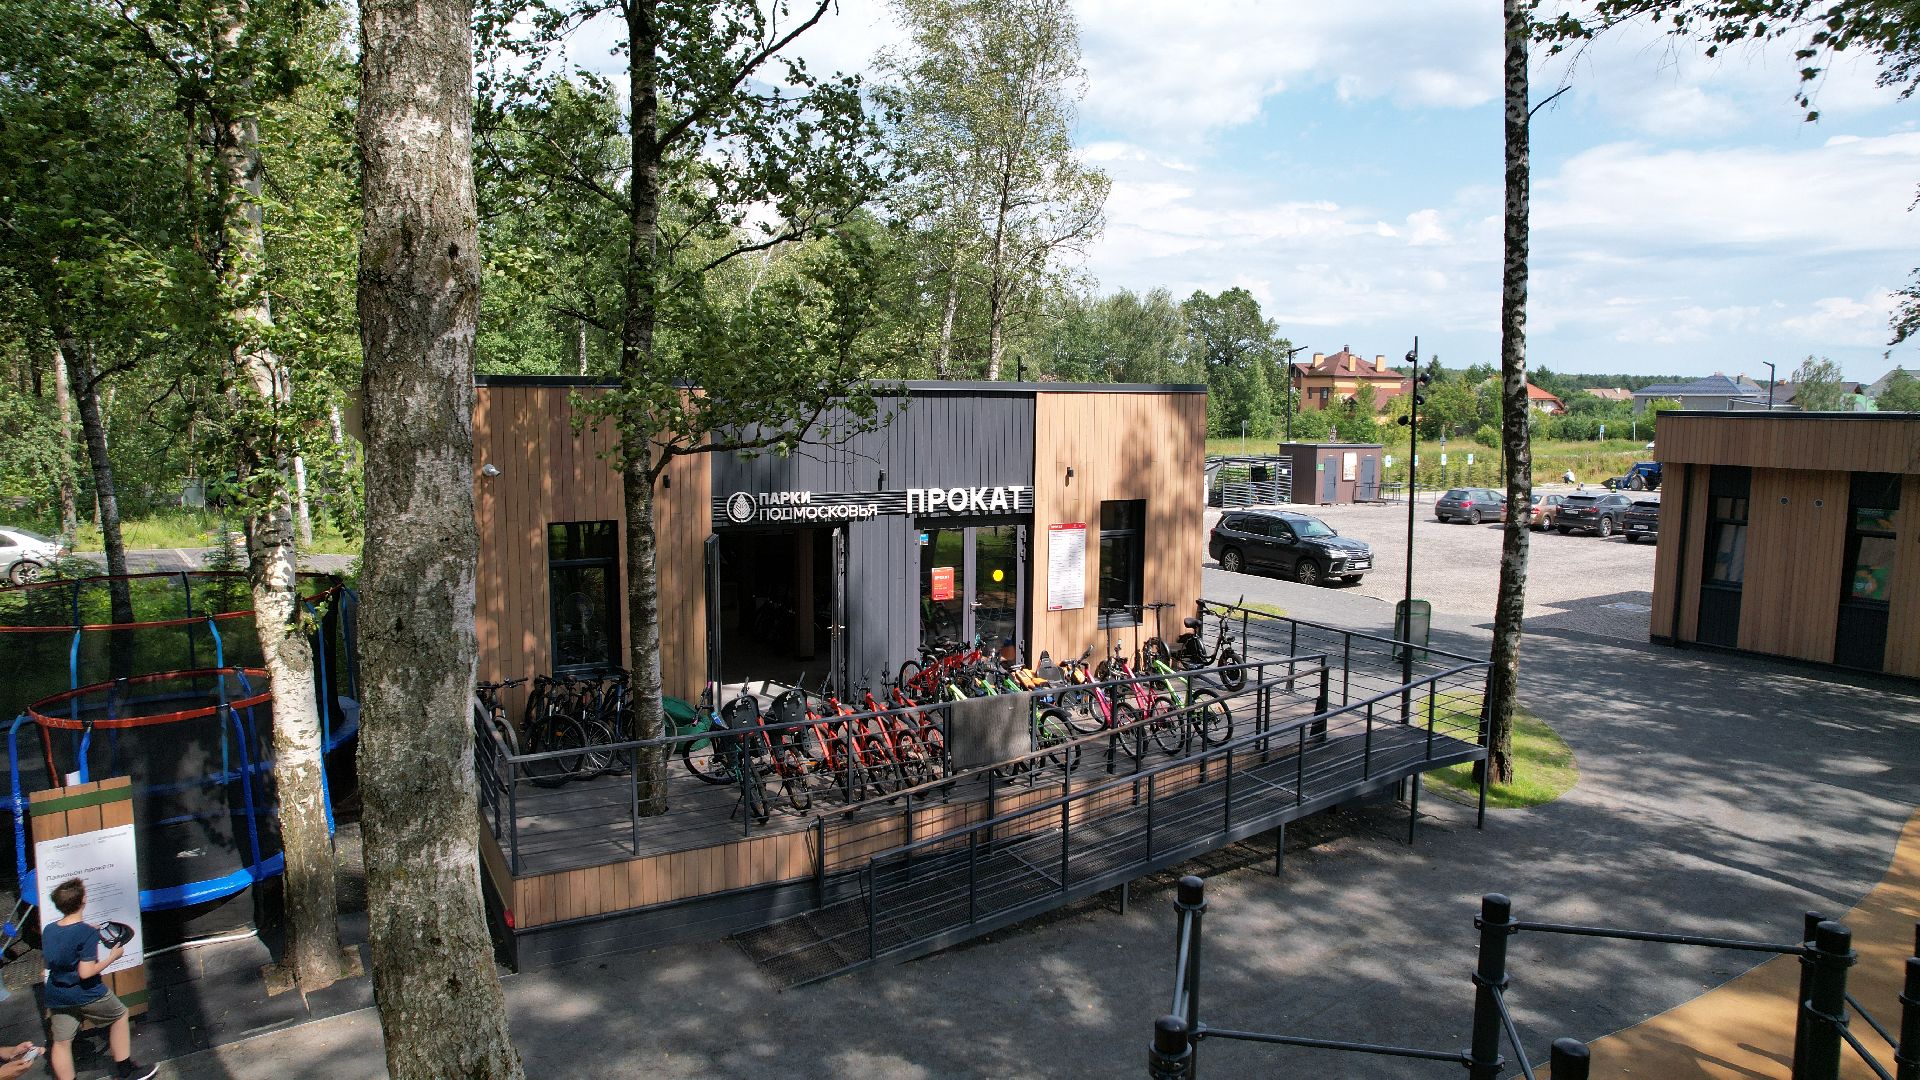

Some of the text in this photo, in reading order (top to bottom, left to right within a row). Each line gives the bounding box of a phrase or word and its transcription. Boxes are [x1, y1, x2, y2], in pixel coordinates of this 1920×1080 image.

[759, 491, 811, 506] ПАРКИ
[906, 486, 1025, 513] ПРОКАТ
[759, 504, 878, 521] ПОДМОСКОВЬЯ
